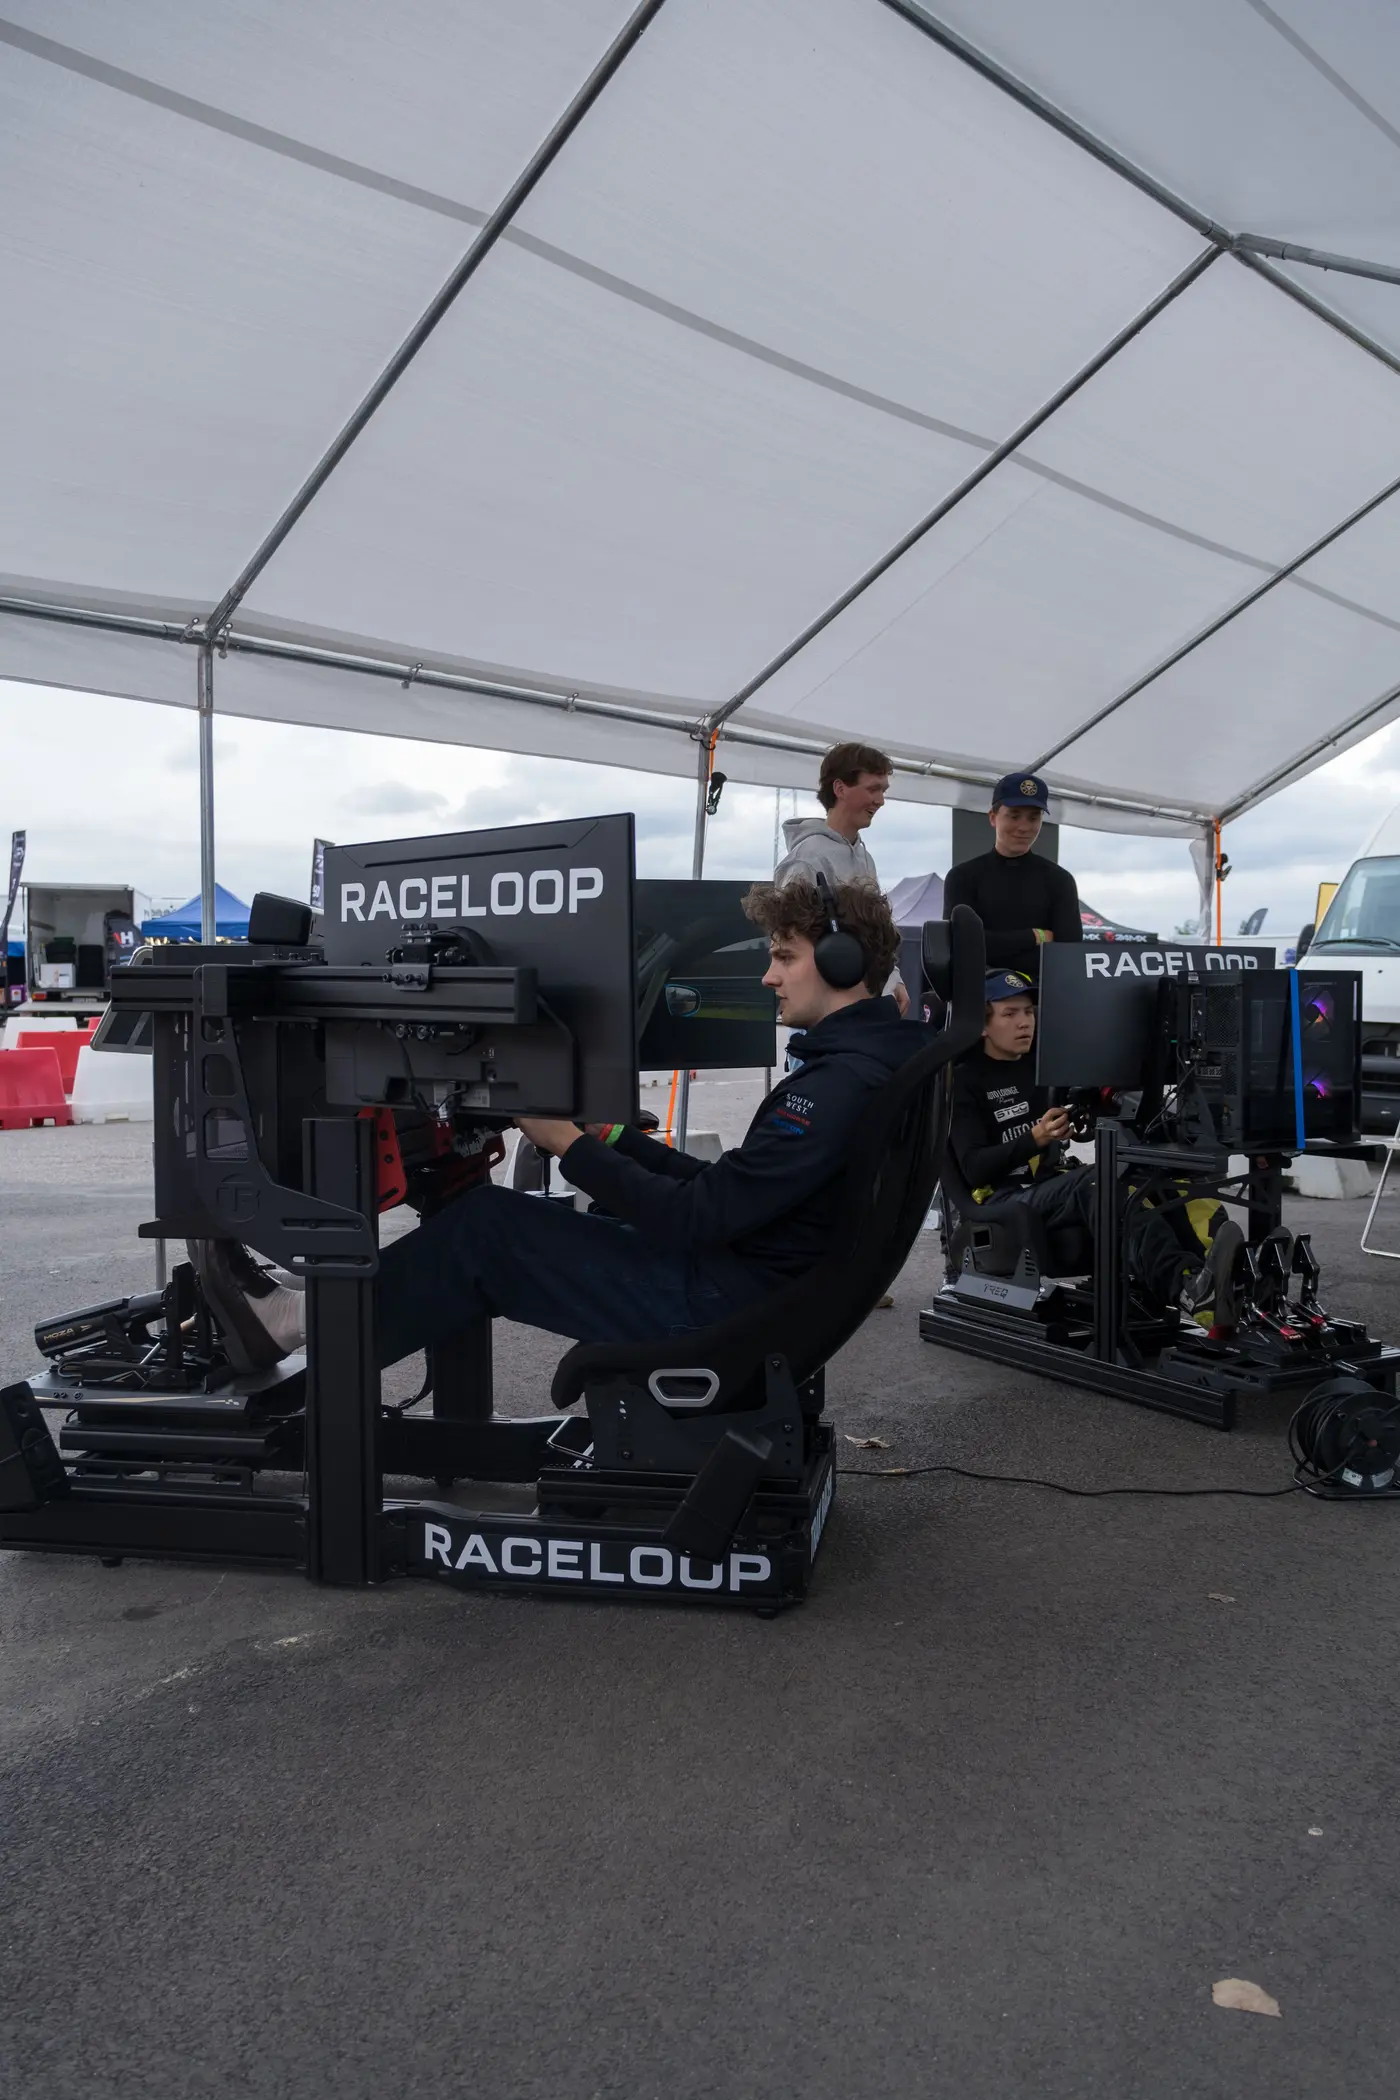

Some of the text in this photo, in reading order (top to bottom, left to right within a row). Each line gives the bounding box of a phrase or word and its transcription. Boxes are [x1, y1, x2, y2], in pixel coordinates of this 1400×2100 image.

[340, 867, 604, 922] RACELOOP
[1082, 933, 1147, 942] MX 24MX
[1085, 951, 1258, 978] RACELOOP
[998, 1085, 1020, 1098] LOUNGE
[785, 1100, 809, 1115] WEST.
[786, 1092, 815, 1109] SOUTH
[43, 1328, 74, 1340] MOZA
[424, 1523, 771, 1592] RACELOOP
